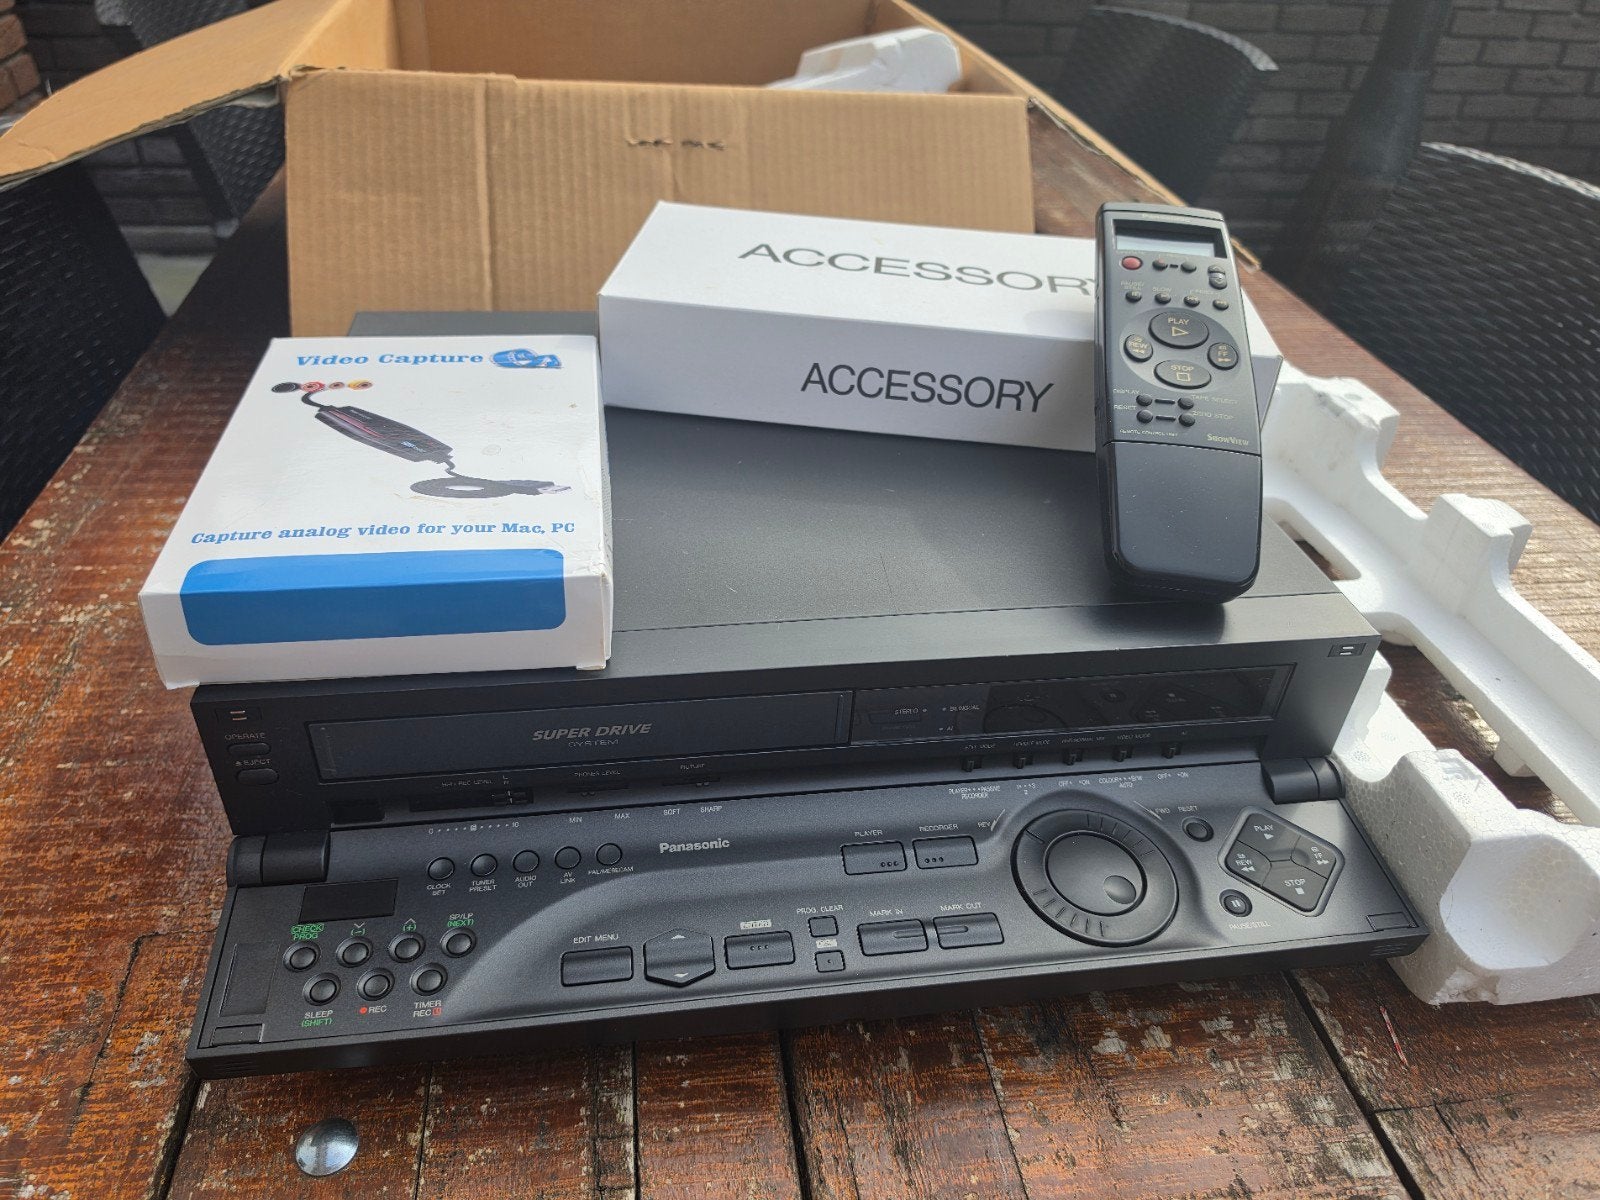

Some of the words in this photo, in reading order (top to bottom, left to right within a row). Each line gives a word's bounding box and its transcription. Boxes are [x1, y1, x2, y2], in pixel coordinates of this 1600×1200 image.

[1167, 317, 1190, 326] PLAY
[296, 353, 368, 367] Video
[379, 352, 484, 367] Capture
[1170, 364, 1195, 372] STOP
[799, 361, 1056, 414] ACCESSORY
[191, 527, 273, 546] Capture
[278, 525, 351, 539] analog
[357, 522, 411, 537] video
[417, 521, 446, 535] for
[451, 523, 496, 536] your
[501, 522, 546, 536] Mac,
[551, 521, 575, 533] PC
[224, 732, 266, 741] OPERATE
[532, 726, 592, 742] SUPER
[594, 722, 653, 737] DRIVE
[568, 739, 619, 748] SYSTEM
[243, 758, 271, 766] EJECT
[663, 808, 681, 816] SOFT
[700, 805, 723, 813] SHARP
[569, 816, 583, 824] MIN
[614, 812, 631, 820] MAX
[919, 823, 959, 833] RECORDER
[1253, 824, 1274, 833] PLAY
[854, 829, 883, 837] PLAYER
[659, 838, 731, 854] Panasonic
[1235, 859, 1254, 867] REW
[471, 878, 496, 887] TUNER
[517, 881, 533, 889] OUT
[1284, 878, 1306, 888] STOP
[469, 884, 498, 893] PRESET
[820, 904, 844, 912] CLEAR
[940, 903, 963, 912] MARK
[966, 901, 982, 909] OUT
[449, 912, 474, 920] SP/LP
[869, 908, 891, 917] MARK
[447, 919, 474, 928] (NEXT)
[293, 932, 318, 941] PROG
[573, 935, 592, 944] EDIT
[594, 933, 619, 943] MENU
[413, 1000, 442, 1009] TIMER
[368, 1005, 387, 1014] REC
[412, 1008, 431, 1018] REC
[304, 1010, 333, 1019] SLEEP
[301, 1017, 333, 1028] (SHIFT)
